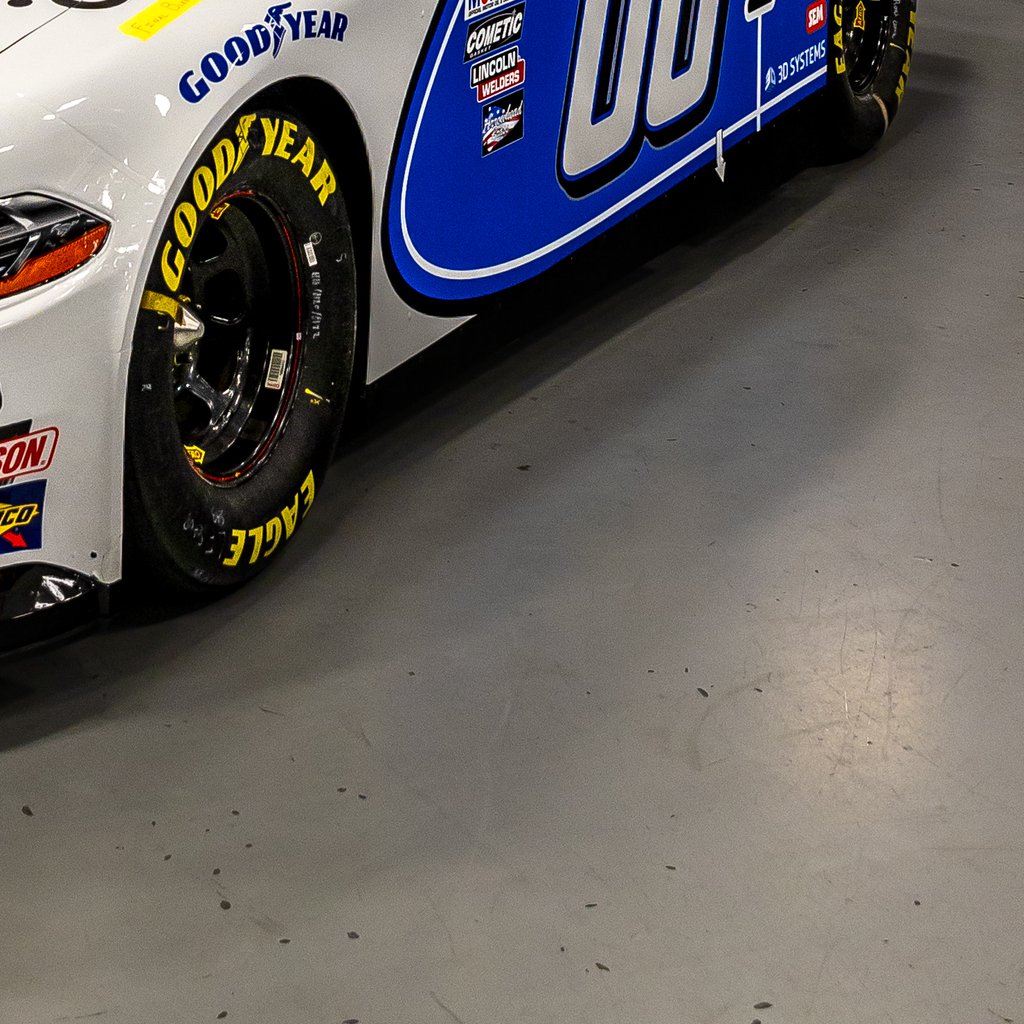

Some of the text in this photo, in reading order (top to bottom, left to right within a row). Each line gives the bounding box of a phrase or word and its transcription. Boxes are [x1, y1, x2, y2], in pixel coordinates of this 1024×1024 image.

[466, 12, 523, 54] COMETIC
[808, 4, 824, 29] SEM
[178, 2, 348, 104] GOODYEAR
[472, 50, 516, 85] LINCOLN
[778, 39, 826, 84] 3D SYSTEMS
[481, 69, 520, 98] WELDERS
[161, 113, 337, 293] GOODYEAR
[223, 469, 315, 566] EAGLE
